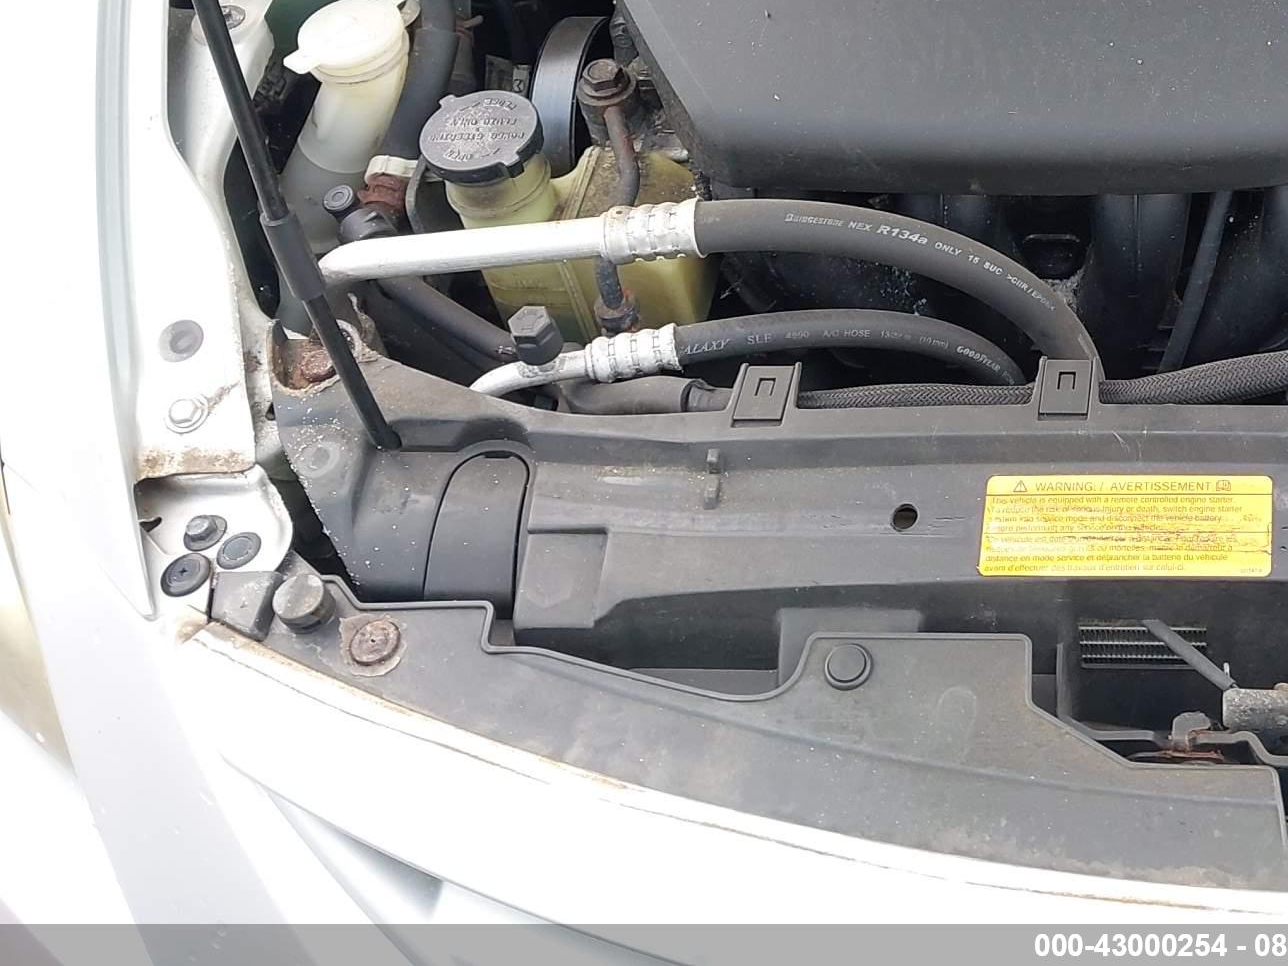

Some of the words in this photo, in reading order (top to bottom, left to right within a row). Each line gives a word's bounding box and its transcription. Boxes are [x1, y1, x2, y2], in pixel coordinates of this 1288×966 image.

[848, 220, 873, 232] NEX
[876, 224, 929, 245] R134a
[934, 242, 962, 256] ONLY
[968, 254, 980, 265] 15
[983, 261, 1004, 275] SUC
[844, 329, 871, 338] HOSE
[1110, 481, 1212, 492] AVERTISSEMENT
[1047, 496, 1084, 506] equipped
[1180, 497, 1207, 505] engine
[1189, 506, 1216, 515] engine
[985, 554, 1018, 562] distance
[1032, 554, 1055, 562] mode
[1152, 553, 1182, 561] batterie
[1183, 553, 1194, 561] du
[983, 564, 1006, 572] avant
